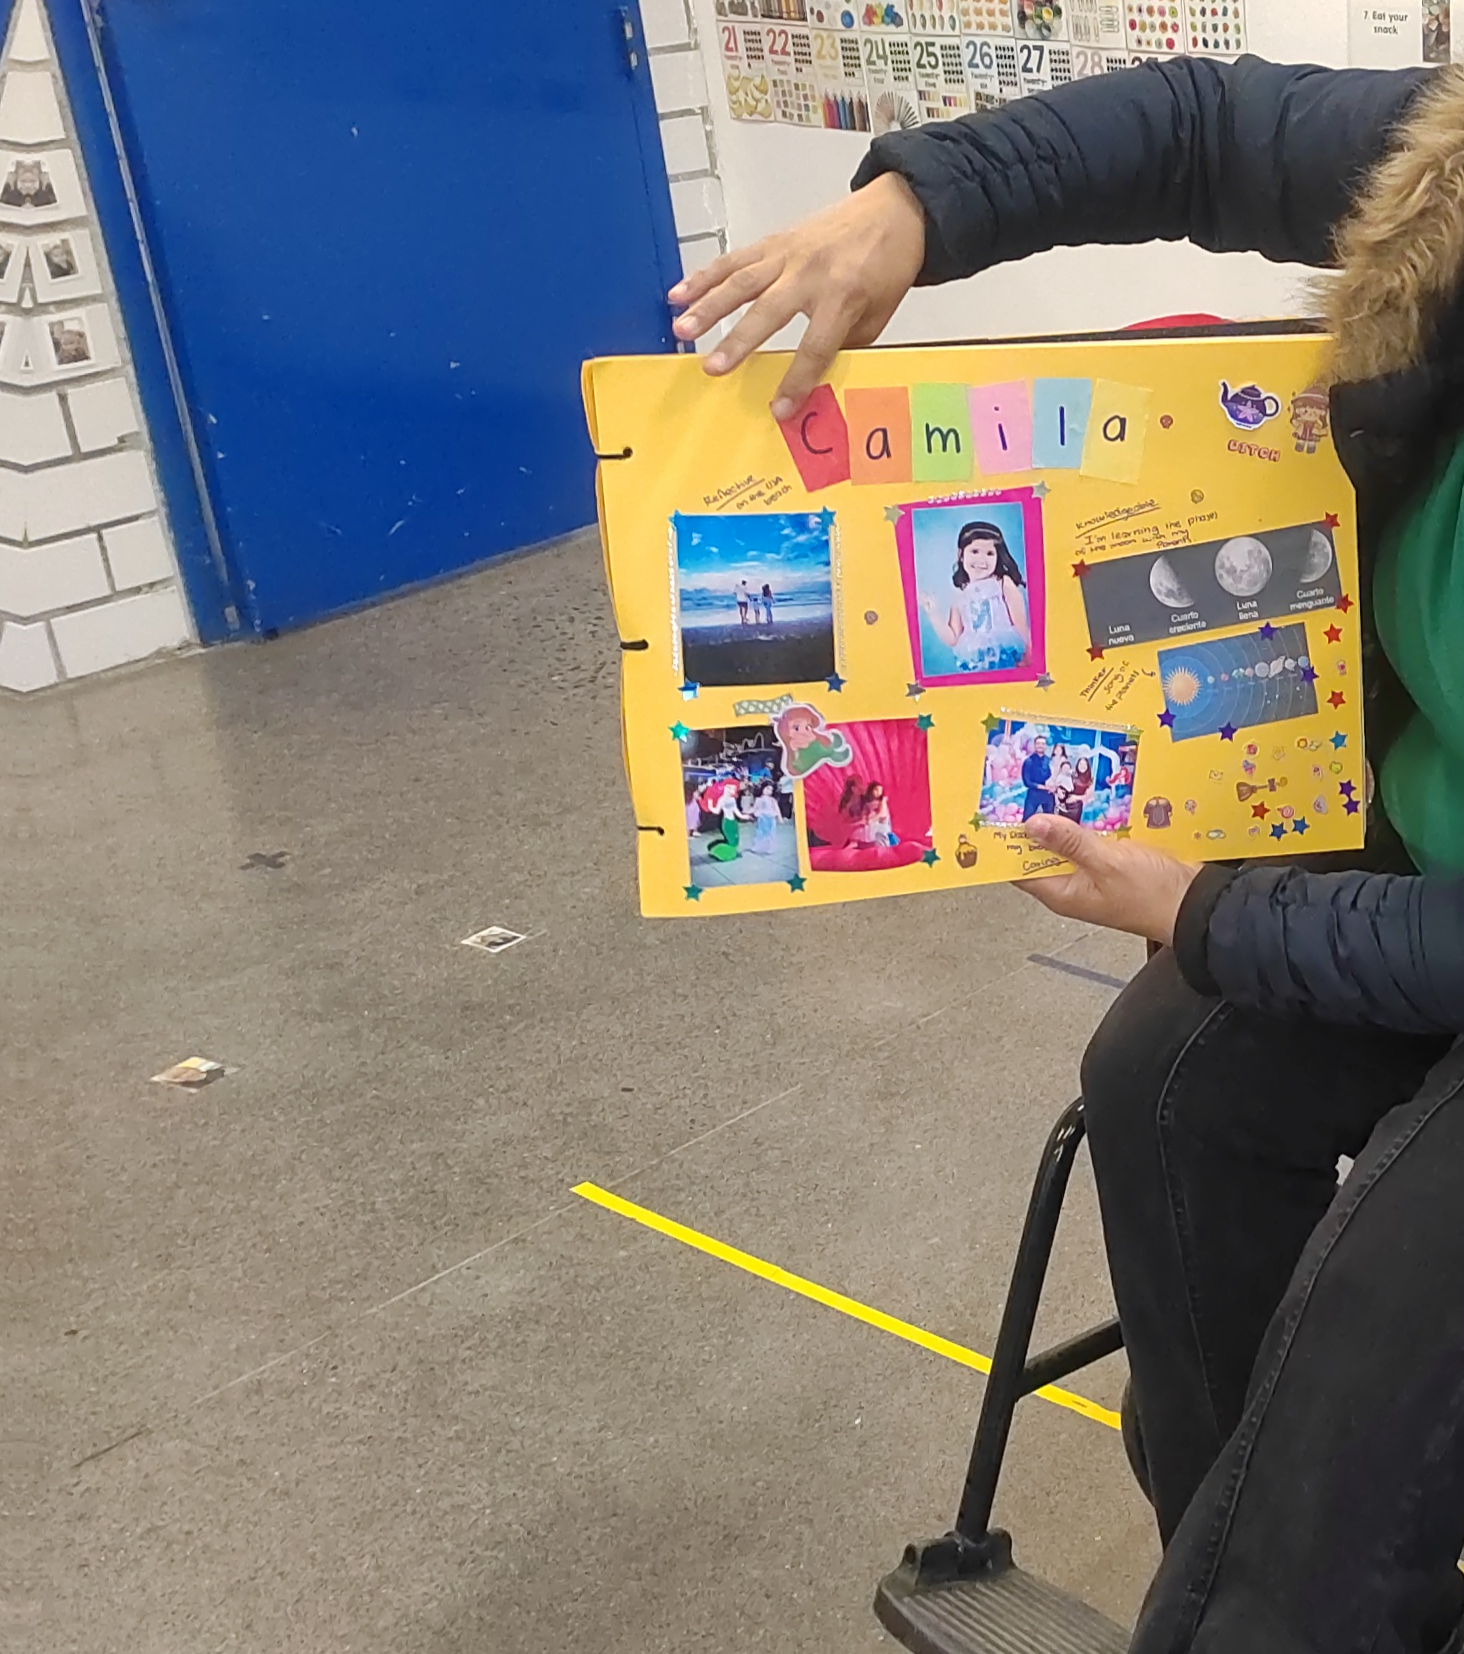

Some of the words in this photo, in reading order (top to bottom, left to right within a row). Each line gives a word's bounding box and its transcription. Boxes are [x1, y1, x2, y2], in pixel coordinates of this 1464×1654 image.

[1372, 11, 1385, 21] Eat
[1388, 13, 1408, 22] your
[1373, 25, 1398, 34] snack
[722, 25, 739, 53] 21
[766, 28, 791, 56] 22
[813, 32, 840, 60] 23
[864, 37, 889, 66] 24
[914, 41, 939, 69] 25
[965, 40, 994, 69] 26
[1019, 44, 1045, 73] 27
[1075, 50, 1105, 77] 28
[1085, 535, 1107, 545] I'm
[1111, 526, 1159, 540] learning
[1165, 520, 1182, 529] the
[1090, 544, 1106, 553] the
[1110, 538, 1137, 549] moon
[1142, 532, 1166, 543] with
[1172, 529, 1189, 541] my
[1296, 587, 1324, 599] Cuarto
[1236, 600, 1258, 611] Luna
[1171, 611, 1199, 623] Cuarto
[1239, 610, 1259, 620] llena
[1108, 623, 1131, 635] Luna
[1169, 621, 1207, 634] creciente
[1108, 634, 1135, 646] nueva
[1079, 666, 1106, 697] Thinker
[993, 831, 1006, 841] My
[1006, 844, 1023, 855] my
[1022, 857, 1061, 871] Caring
